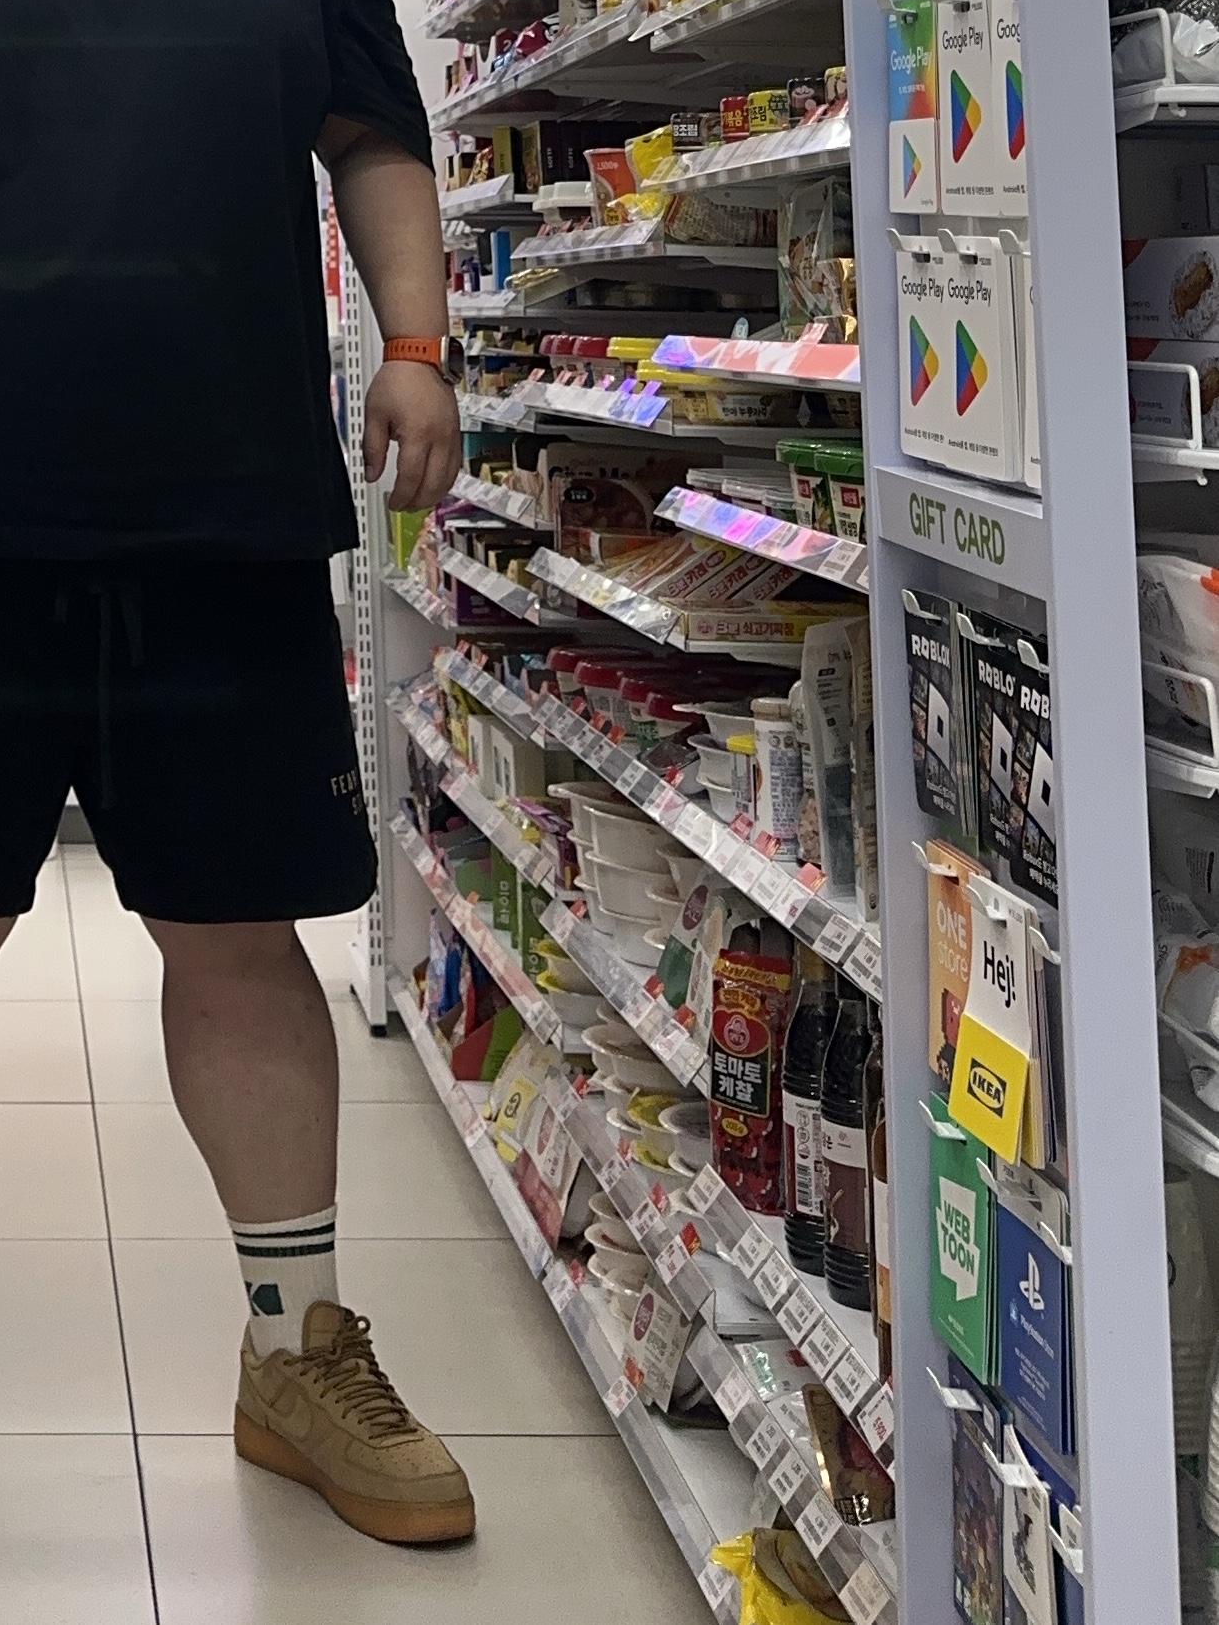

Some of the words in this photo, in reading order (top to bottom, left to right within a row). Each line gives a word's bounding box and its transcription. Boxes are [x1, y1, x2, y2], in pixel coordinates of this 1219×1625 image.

[943, 30, 968, 54] Google
[969, 26, 984, 50] Play
[890, 49, 916, 74] Google
[901, 275, 927, 301] Google
[928, 278, 944, 303] Play
[947, 278, 975, 305] Google
[976, 280, 992, 307] Play
[909, 492, 946, 545] GIFT
[953, 507, 1005, 566] CARD
[936, 900, 968, 951] ONE
[937, 940, 969, 983] store
[983, 939, 1017, 1009] Hej!
[713, 1053, 762, 1085] 토마토
[972, 1070, 1003, 1105] IKEA
[944, 1199, 971, 1246] WEB
[940, 1221, 976, 1278] TOON
